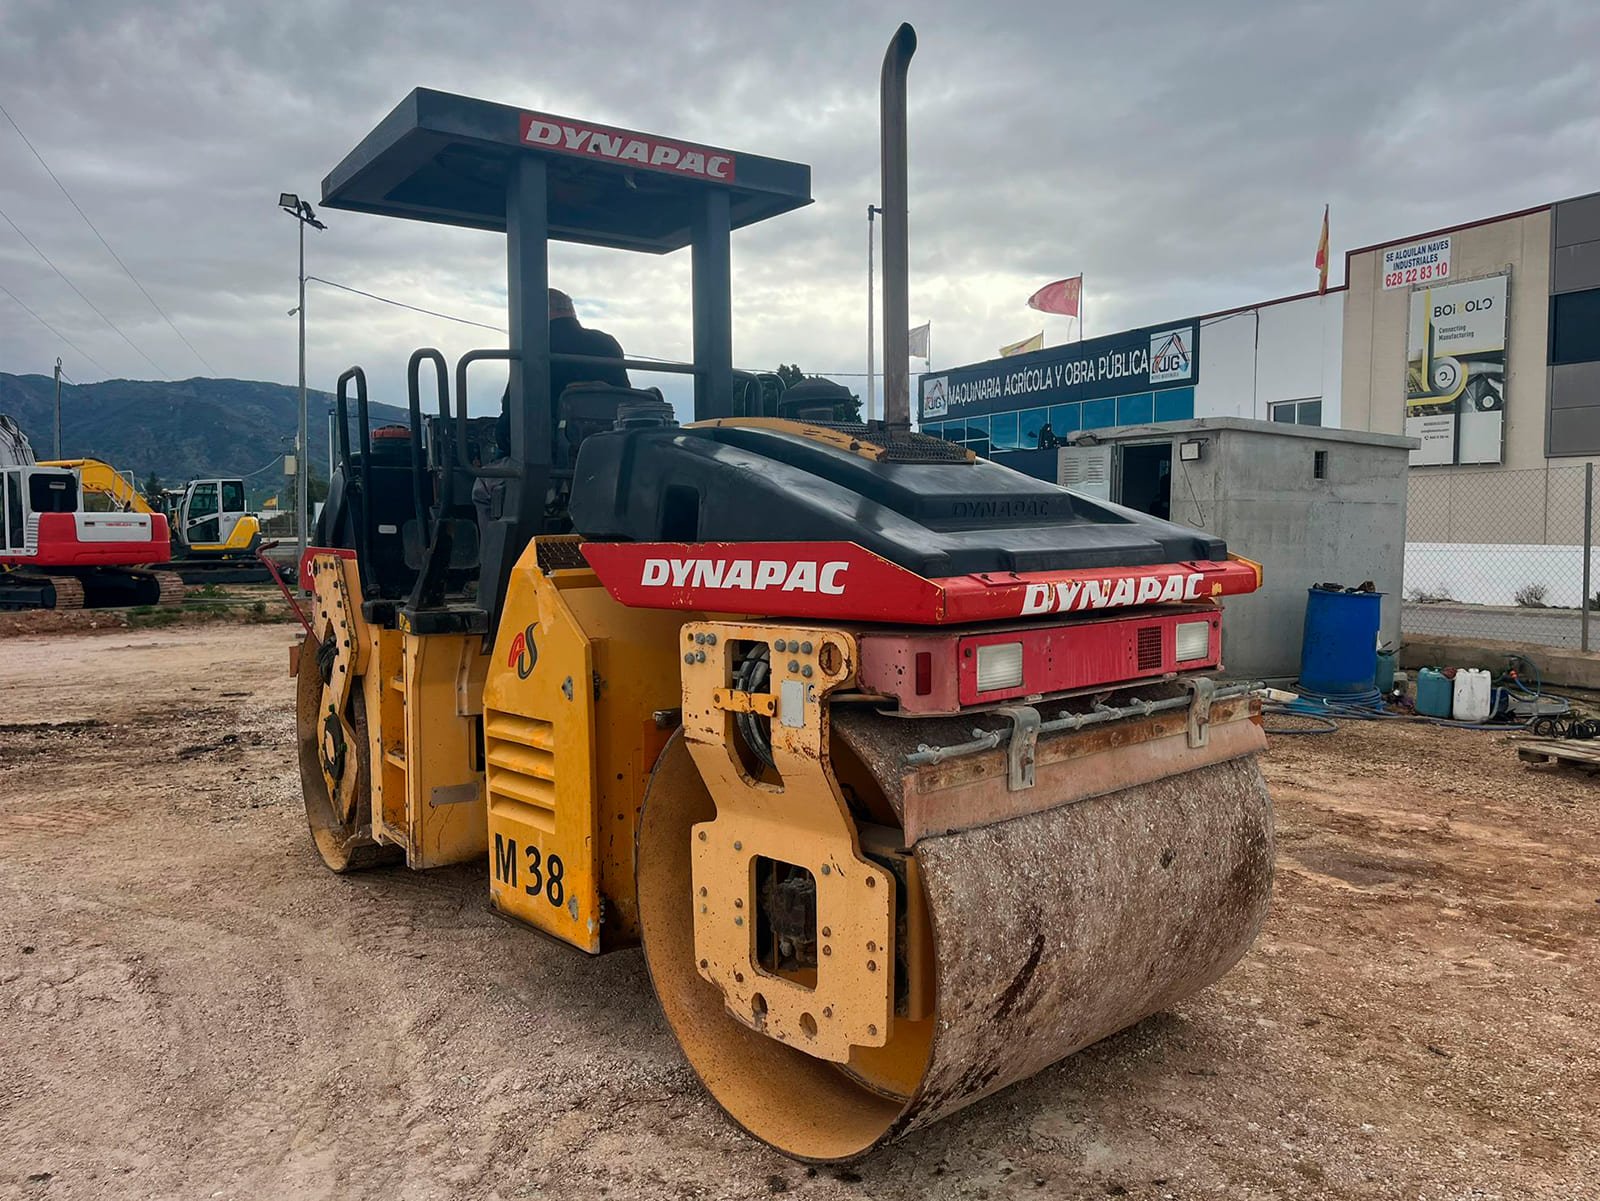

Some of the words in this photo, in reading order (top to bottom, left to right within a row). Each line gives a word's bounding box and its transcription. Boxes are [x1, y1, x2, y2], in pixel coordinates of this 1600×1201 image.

[526, 120, 730, 178] DYNAPAC
[1386, 252, 1394, 262] SE
[1395, 245, 1426, 260] ALQUILAN
[1427, 240, 1449, 252] NAVES
[1393, 253, 1438, 271] INDUSTRIALES
[1386, 271, 1403, 287] 628
[1405, 268, 1417, 283] 22
[1420, 265, 1432, 280] 83
[1436, 262, 1447, 277] 10
[1438, 325, 1466, 334] Connecting
[1438, 331, 1475, 341] Manufacturing
[948, 377, 1001, 406] MAQUINARIA
[1004, 367, 1053, 397] AGRÍCOLA
[1055, 364, 1063, 387] Y
[1065, 359, 1095, 384] OBRA
[1098, 349, 1149, 380] PÚBLICA
[952, 501, 1049, 518] DYNAPAC
[641, 559, 849, 595] DYNAPAC
[1020, 573, 1204, 616] DYNAPAC
[495, 833, 517, 888] M
[525, 845, 564, 908] 38
